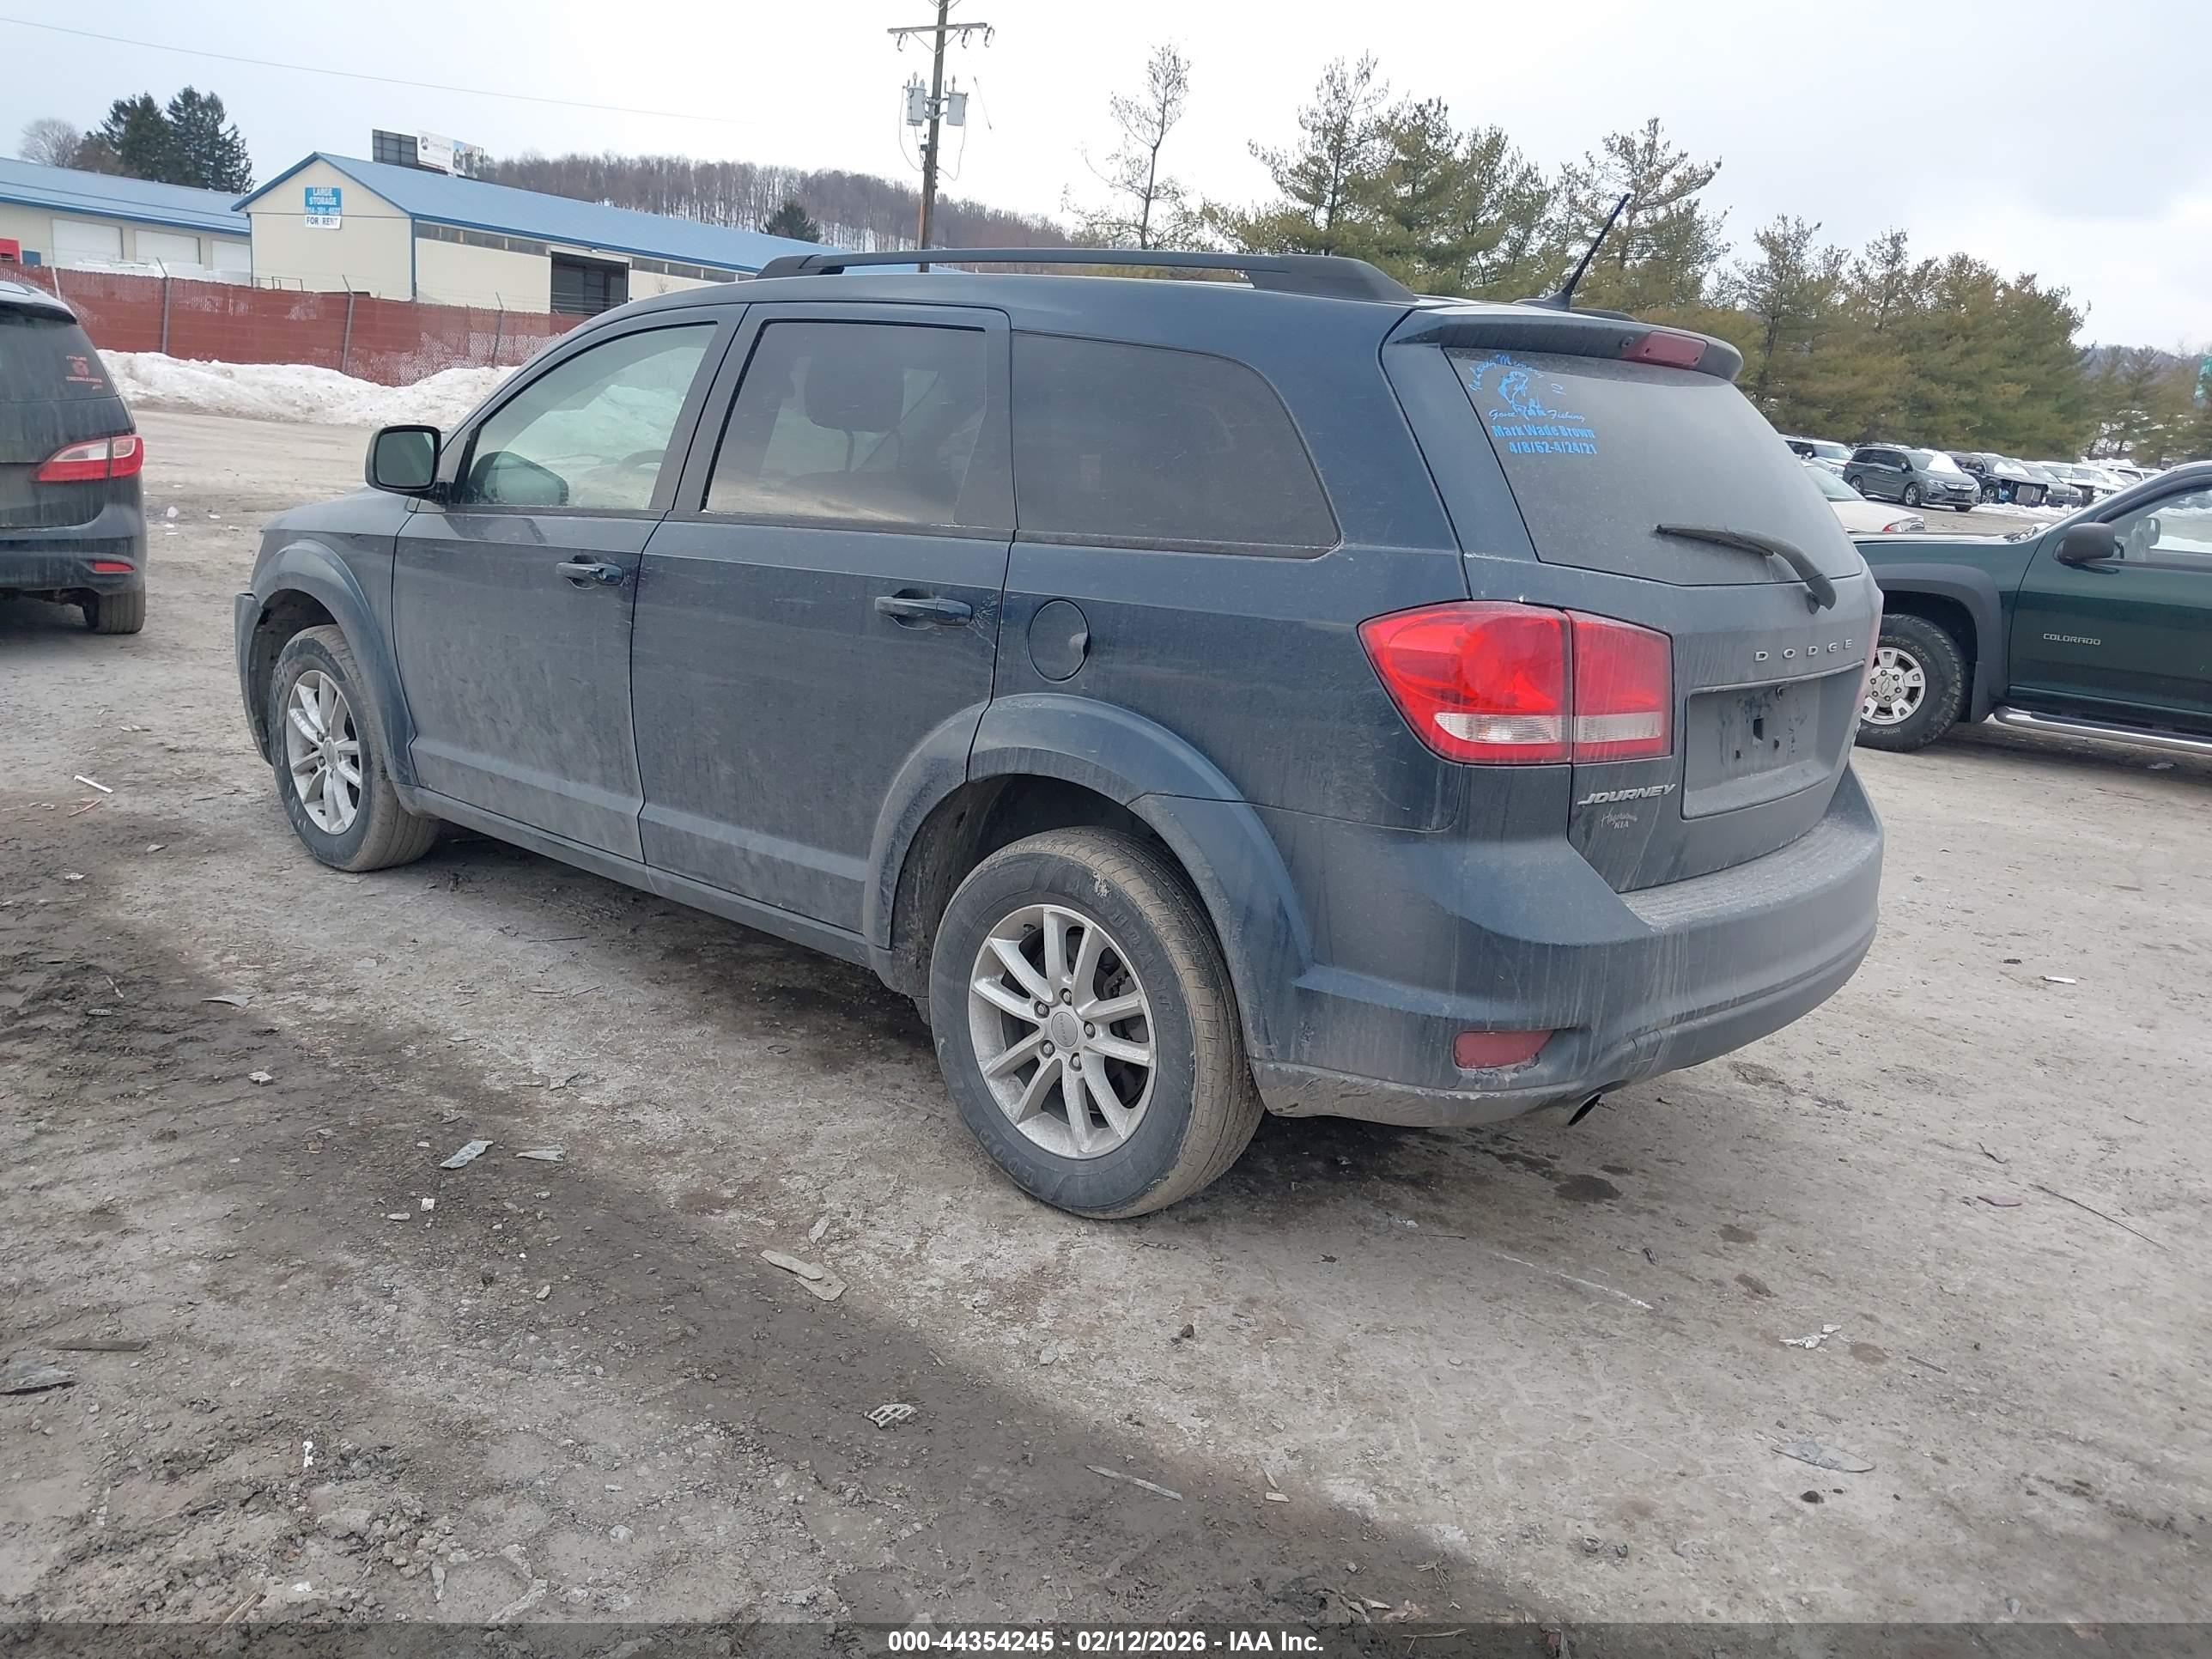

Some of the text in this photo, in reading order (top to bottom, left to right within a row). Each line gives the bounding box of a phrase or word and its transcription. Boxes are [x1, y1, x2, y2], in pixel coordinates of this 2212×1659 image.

[309, 197, 337, 205] STORAGE
[1489, 409, 1586, 423] Gone Fishing
[1492, 423, 1595, 440] Mark Wade Brown
[1509, 441, 1597, 455] 4/8/62-4/24/21
[2043, 633, 2101, 646] COLORADO
[1754, 639, 1854, 662] DODGE
[1577, 783, 1676, 805] JOURNEY
[1614, 820, 1629, 830] KIA
